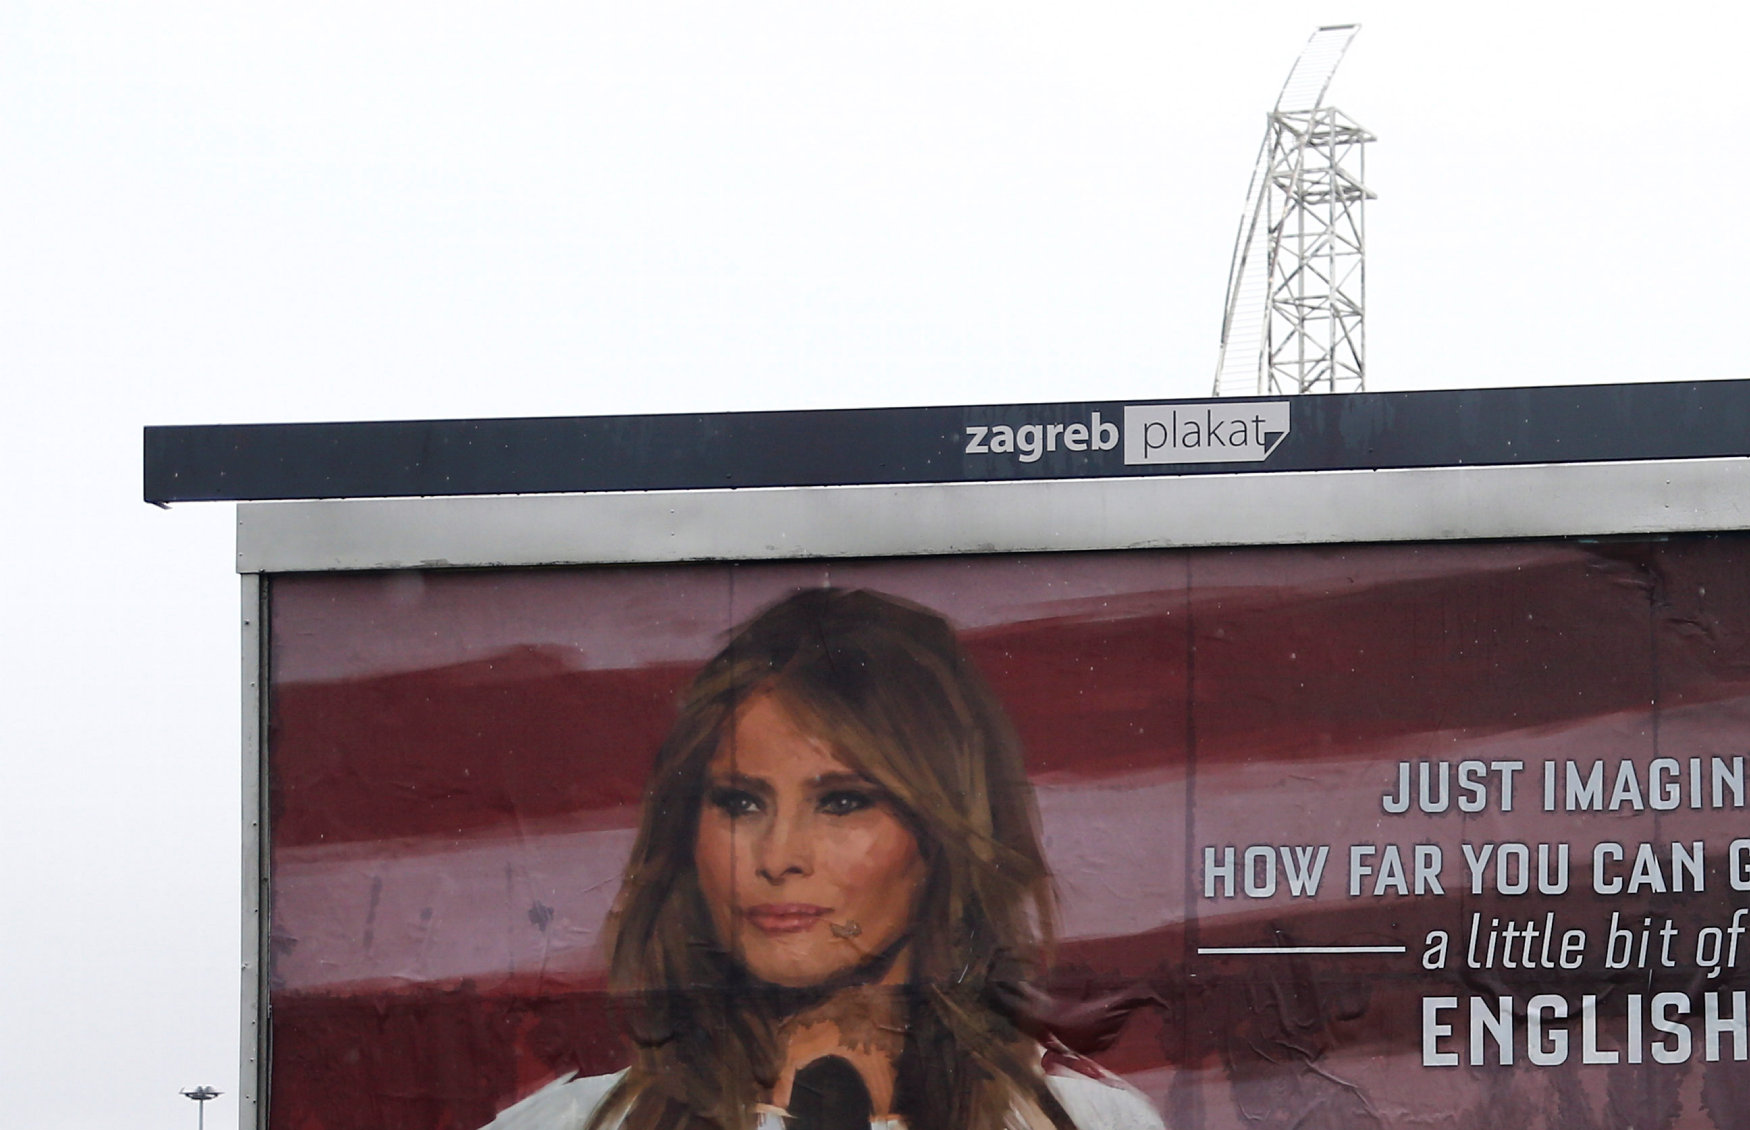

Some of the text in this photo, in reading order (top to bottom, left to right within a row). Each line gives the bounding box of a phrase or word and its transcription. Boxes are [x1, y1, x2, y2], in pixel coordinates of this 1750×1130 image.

[965, 409, 1266, 463] zagreb plakat
[1383, 760, 1524, 814] JUST
[1203, 845, 1329, 898] HOW
[1349, 843, 1444, 896] FAR
[1463, 842, 1569, 895] YOU
[1593, 840, 1704, 894] CAN
[1421, 909, 1749, 979] a little bit of
[1422, 990, 1749, 1067] ENGLISH
